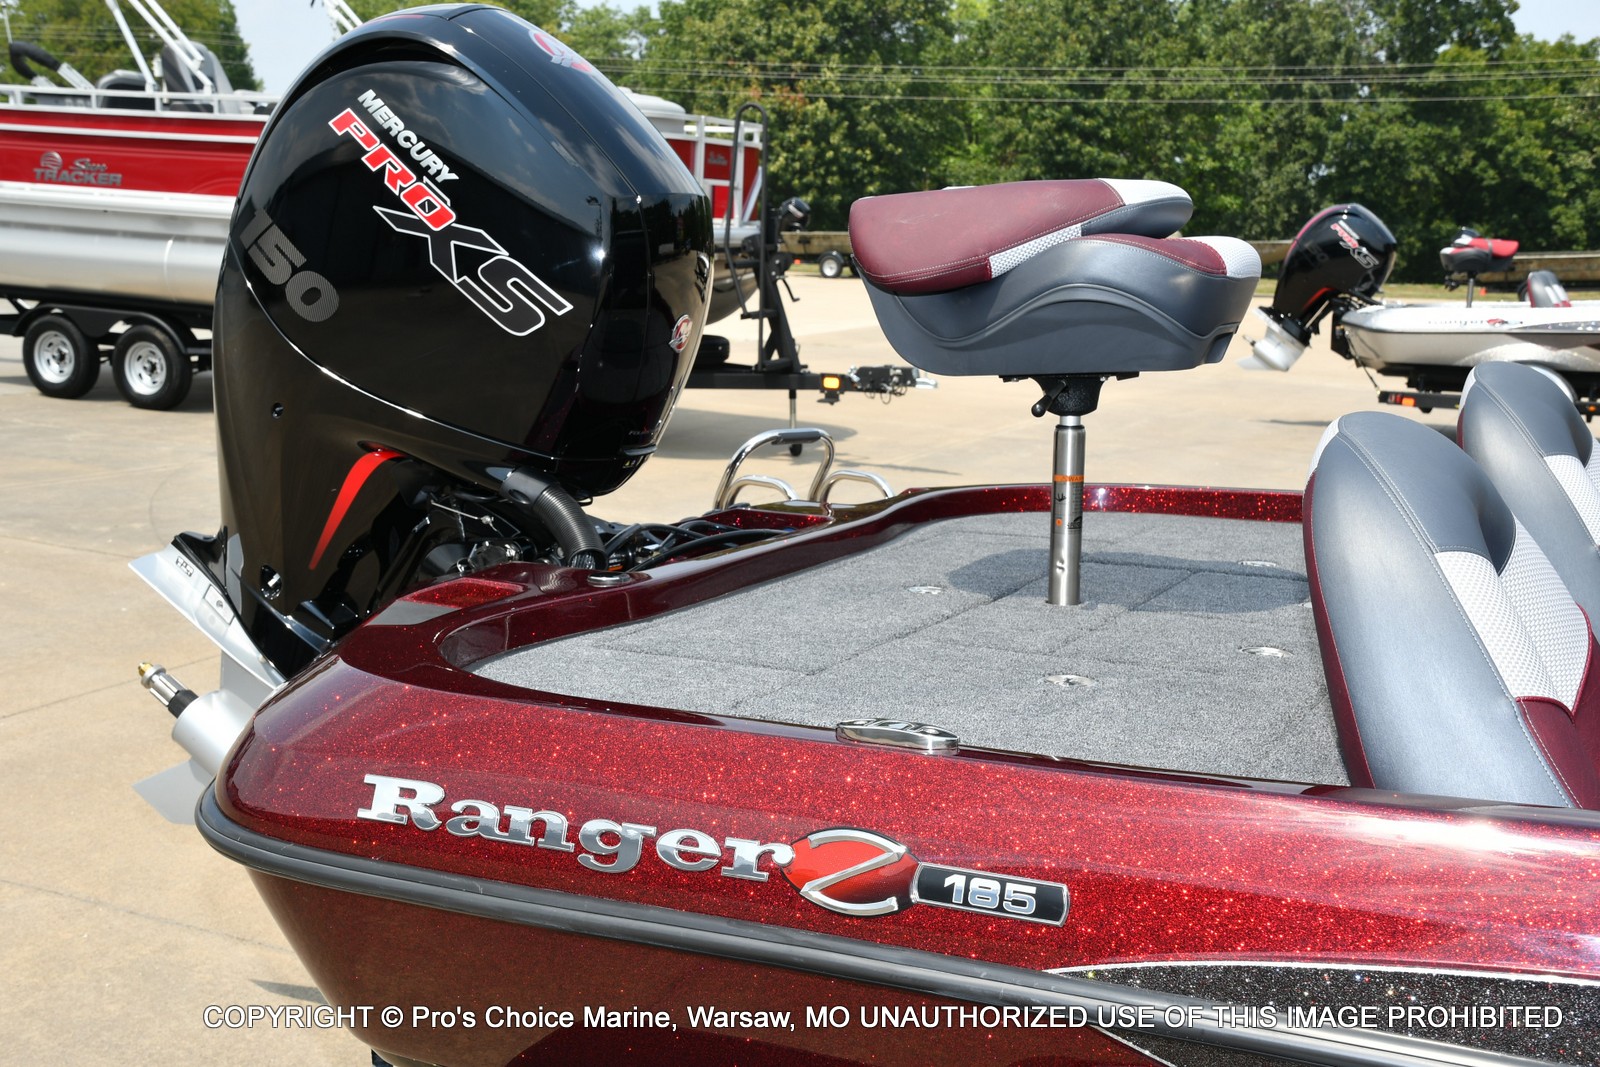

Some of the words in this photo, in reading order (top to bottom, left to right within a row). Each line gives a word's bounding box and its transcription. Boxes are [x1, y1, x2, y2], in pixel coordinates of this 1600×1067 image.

[33, 168, 123, 186] TRACKER
[327, 107, 457, 232] PRO
[357, 88, 460, 184] MERCURY
[240, 207, 340, 323] 150
[372, 176, 574, 337] XS
[356, 773, 796, 883] Ranger
[943, 873, 1037, 915] 185
